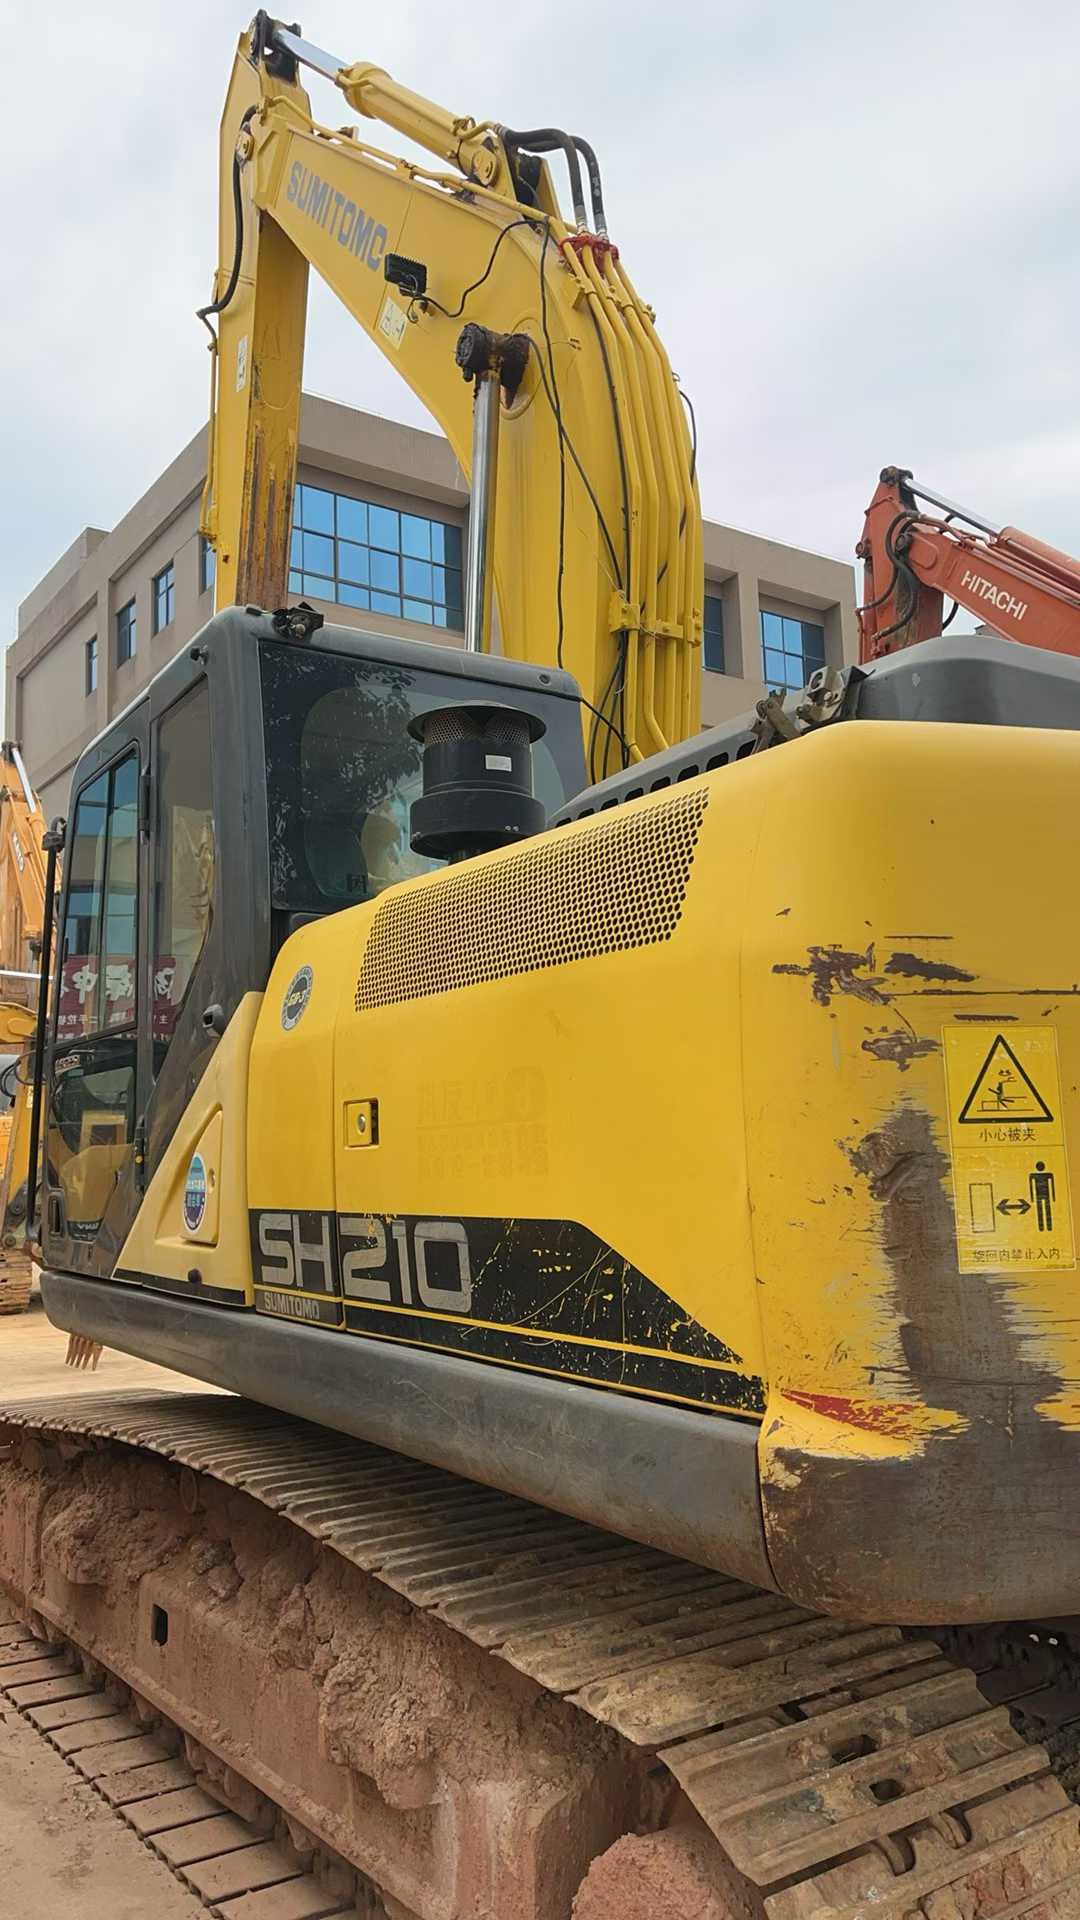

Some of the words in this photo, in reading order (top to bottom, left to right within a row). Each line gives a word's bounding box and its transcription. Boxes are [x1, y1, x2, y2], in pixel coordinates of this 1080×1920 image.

[287, 160, 388, 272] SUMITOMO
[961, 570, 1028, 620] HITACHI
[979, 1127, 1037, 1142] 小心被夹
[259, 1213, 472, 1313] SH210
[264, 1292, 320, 1320] SUMITOMO
